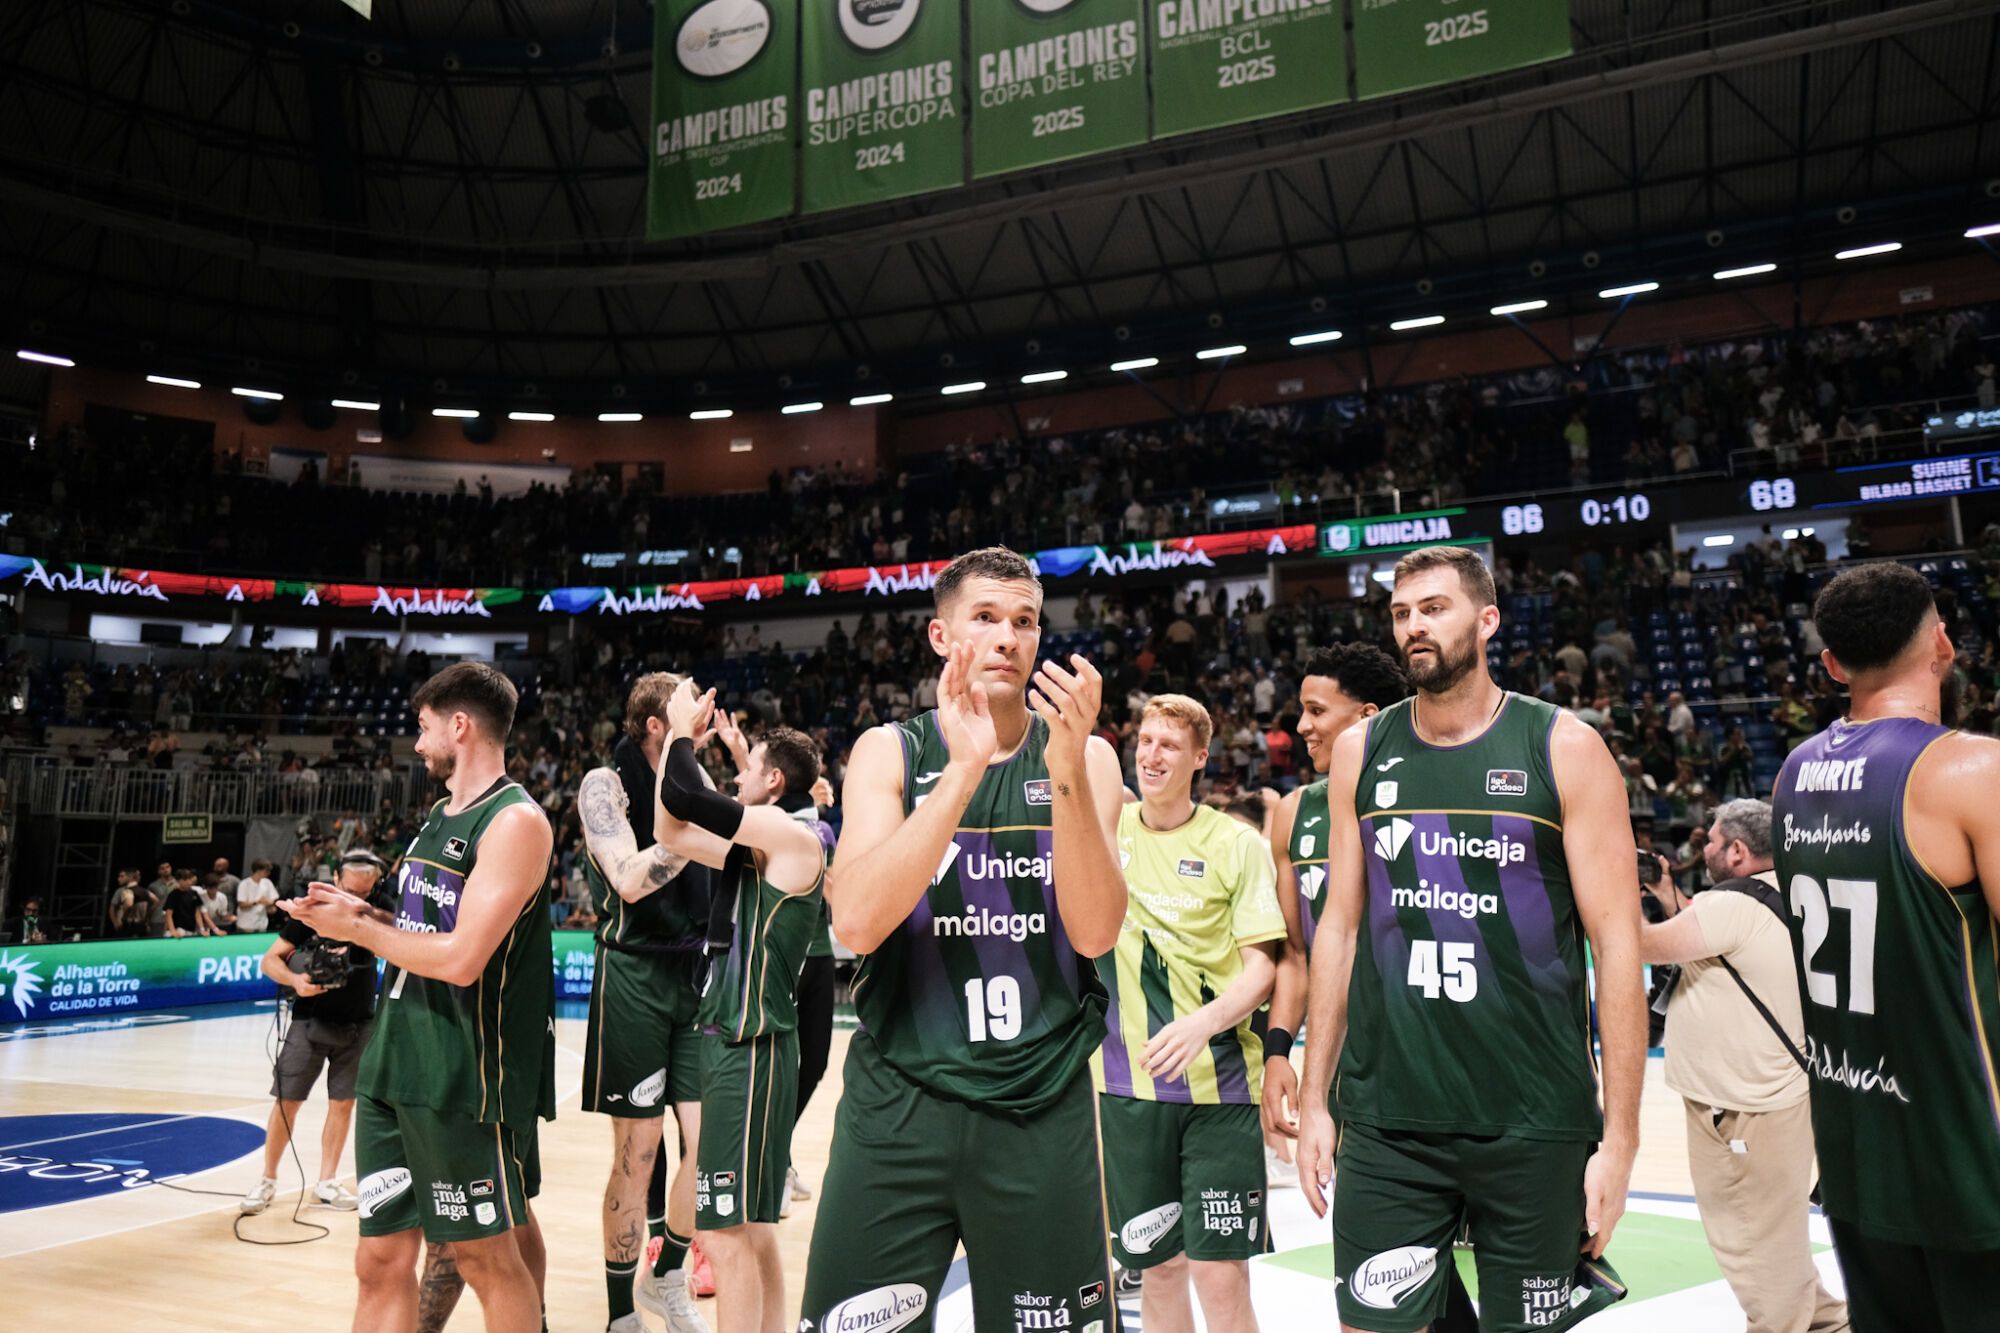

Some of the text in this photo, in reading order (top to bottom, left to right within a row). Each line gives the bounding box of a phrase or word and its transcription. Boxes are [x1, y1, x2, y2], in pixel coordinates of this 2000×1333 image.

[1425, 9, 1489, 46] 2025
[979, 20, 1137, 89] CAMPEONES
[1220, 30, 1271, 59] BCL
[980, 57, 1136, 108] COPA DEL REY
[1218, 55, 1276, 88] 2025
[807, 60, 952, 122] CAMPEONES
[656, 95, 787, 156] CAMPEONES
[809, 97, 956, 145] SUPERCOPA
[1032, 105, 1084, 137] 2025
[856, 142, 905, 170] 2024
[696, 173, 742, 200] 2024
[1912, 458, 1971, 480] SURNE
[1749, 478, 1796, 511] 68
[1860, 475, 1972, 500] BILBAO BASKET
[1501, 503, 1544, 536] 86
[1580, 494, 1650, 526] 0:10
[1365, 517, 1452, 546] UNICAJA
[1090, 536, 1216, 577] Andalucía
[23, 558, 169, 602] Andalucía
[372, 586, 492, 617] Andalucía
[599, 583, 704, 615] Andalucía
[1795, 757, 1867, 792] DUARTE
[1420, 832, 1526, 867] Unicaja
[966, 851, 1052, 886] Unicaj
[409, 875, 457, 909] Unicaja
[565, 950, 595, 966] Alha
[1790, 874, 1878, 1016] 27
[53, 961, 127, 980] Alhaurín
[1407, 939, 1478, 1003] 45
[49, 995, 138, 1011] CALIDAD DE VIDA
[51, 978, 140, 997] de la Torre
[964, 975, 1022, 1042] 19
[432, 1180, 452, 1190] sabor
[1201, 1188, 1229, 1199] sabor
[434, 1199, 469, 1221] laga
[1209, 1193, 1243, 1215] má
[1126, 1204, 1181, 1246] famadesa
[1204, 1211, 1244, 1236] laga
[1014, 1291, 1052, 1306] sabor
[1083, 1291, 1099, 1305] acb
[1522, 1276, 1560, 1289] sabor
[1532, 1276, 1569, 1308] má
[836, 1289, 923, 1333] famadesa
[1022, 1298, 1072, 1328] má
